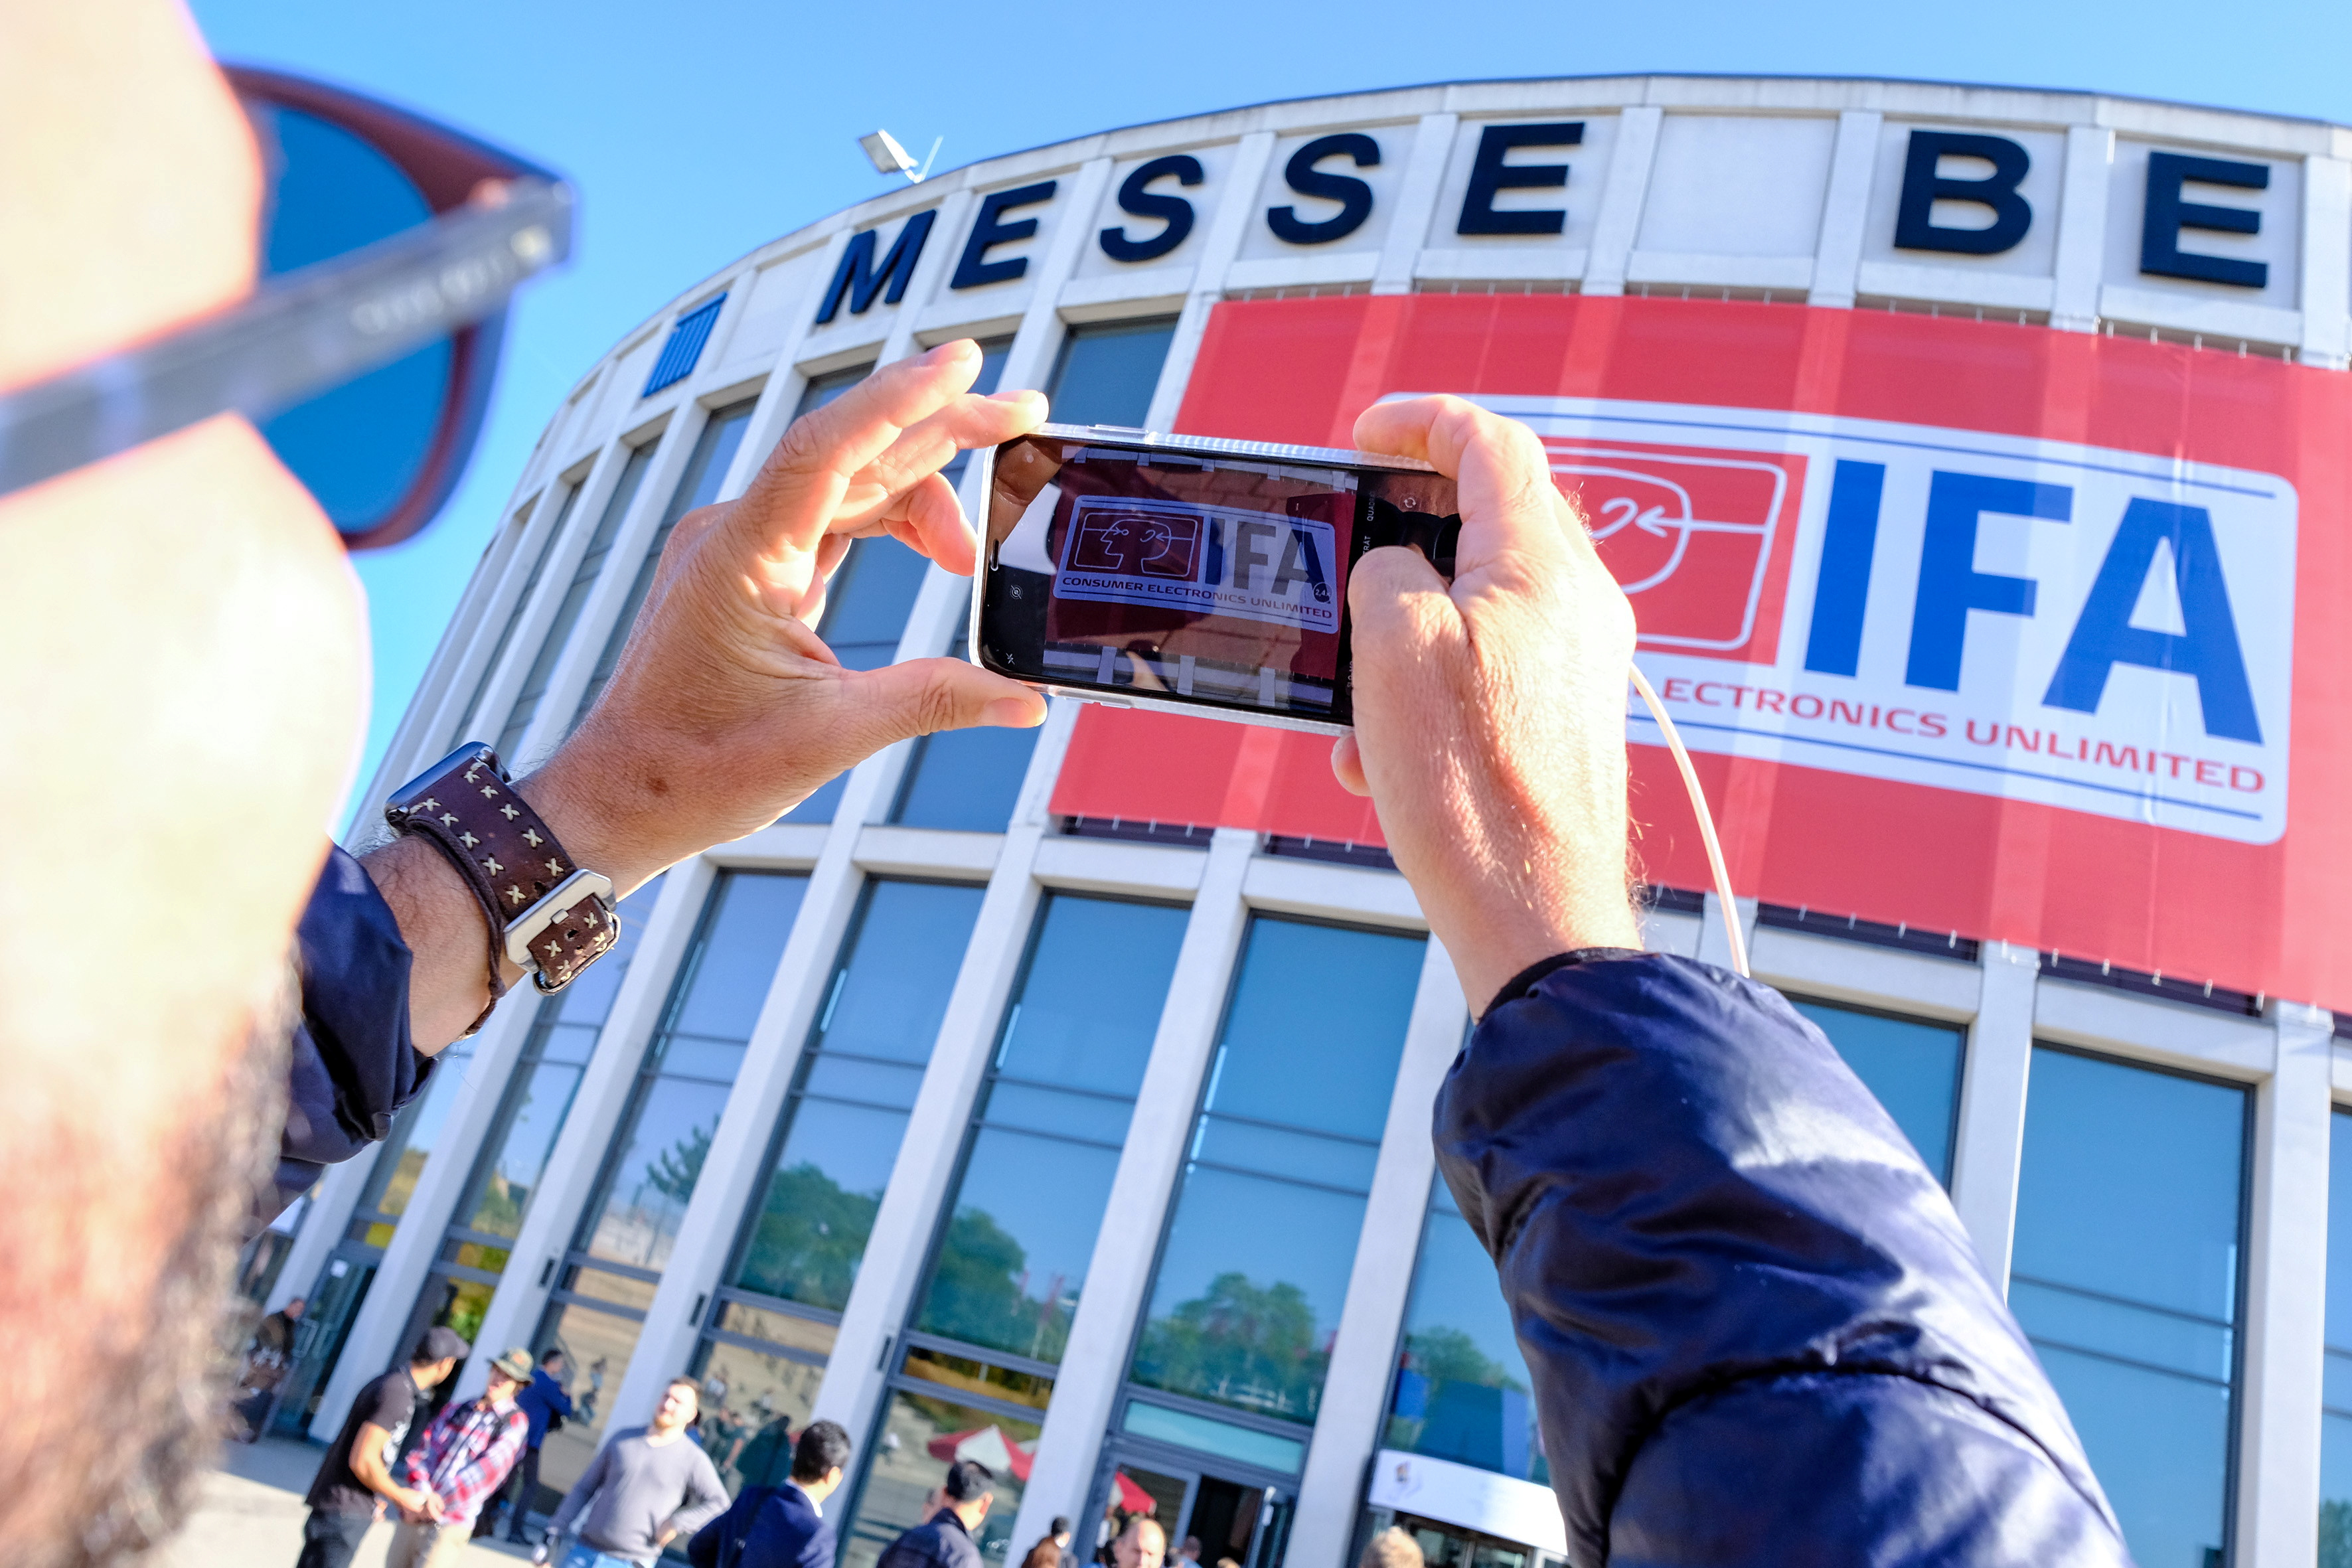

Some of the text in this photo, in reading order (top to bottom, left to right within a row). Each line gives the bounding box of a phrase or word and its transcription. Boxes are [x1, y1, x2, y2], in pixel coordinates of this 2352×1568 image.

[815, 121, 2270, 326] MESSE BE
[1061, 576, 1333, 619] CONSUMER ELECTRONICS UNLIMITED
[1205, 516, 1331, 604] IFA
[1802, 456, 2265, 747] IFA
[1634, 676, 2267, 794] ECTRONICS UNLIMITED
